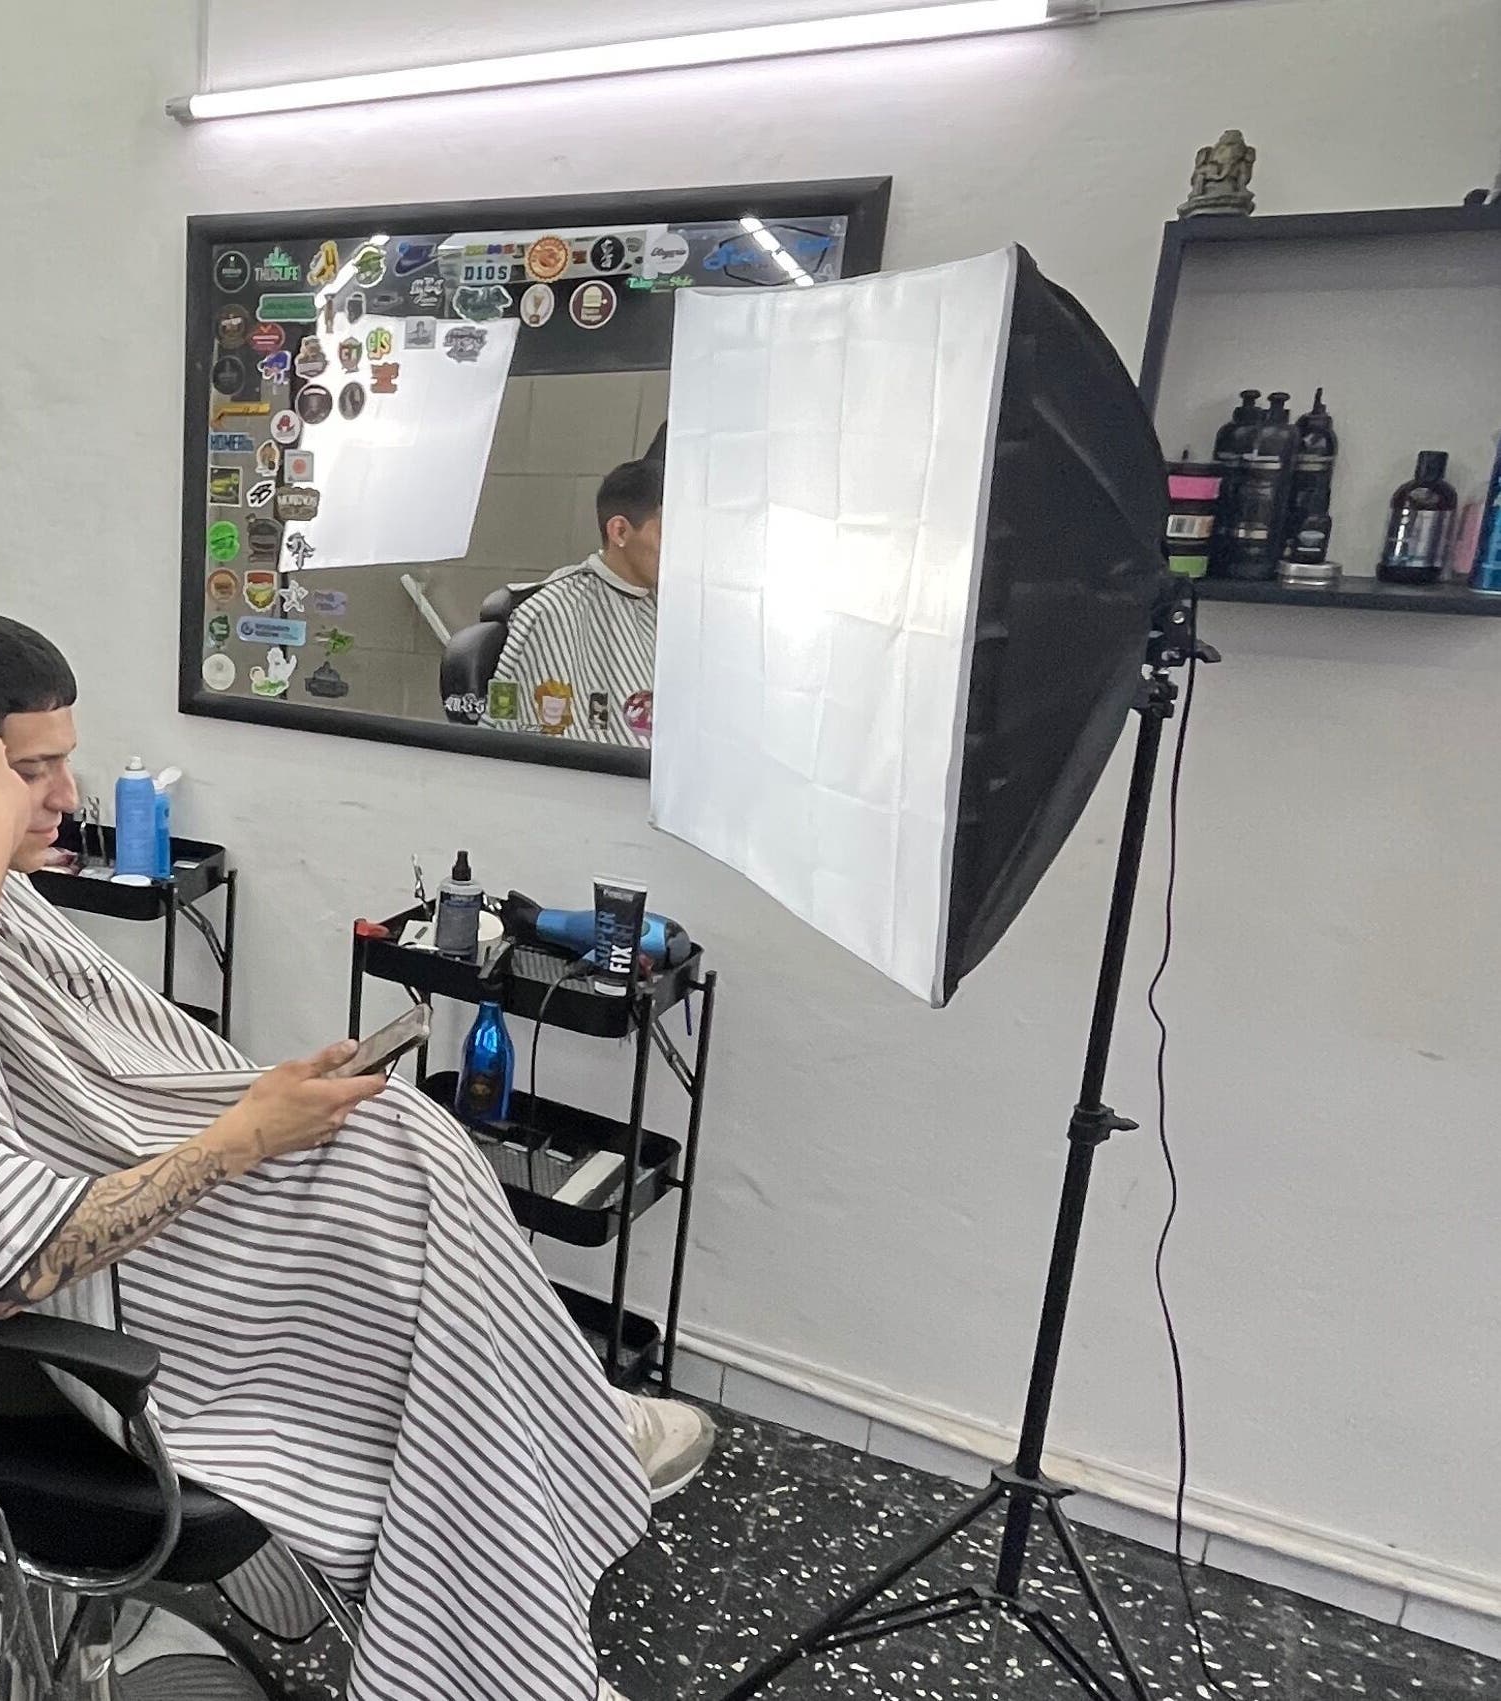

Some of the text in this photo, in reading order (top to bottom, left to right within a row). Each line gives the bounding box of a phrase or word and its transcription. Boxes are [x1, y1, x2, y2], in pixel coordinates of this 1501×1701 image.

[464, 265, 508, 281] DIOS
[597, 911, 615, 970] SUPER
[609, 945, 632, 973] FIX
